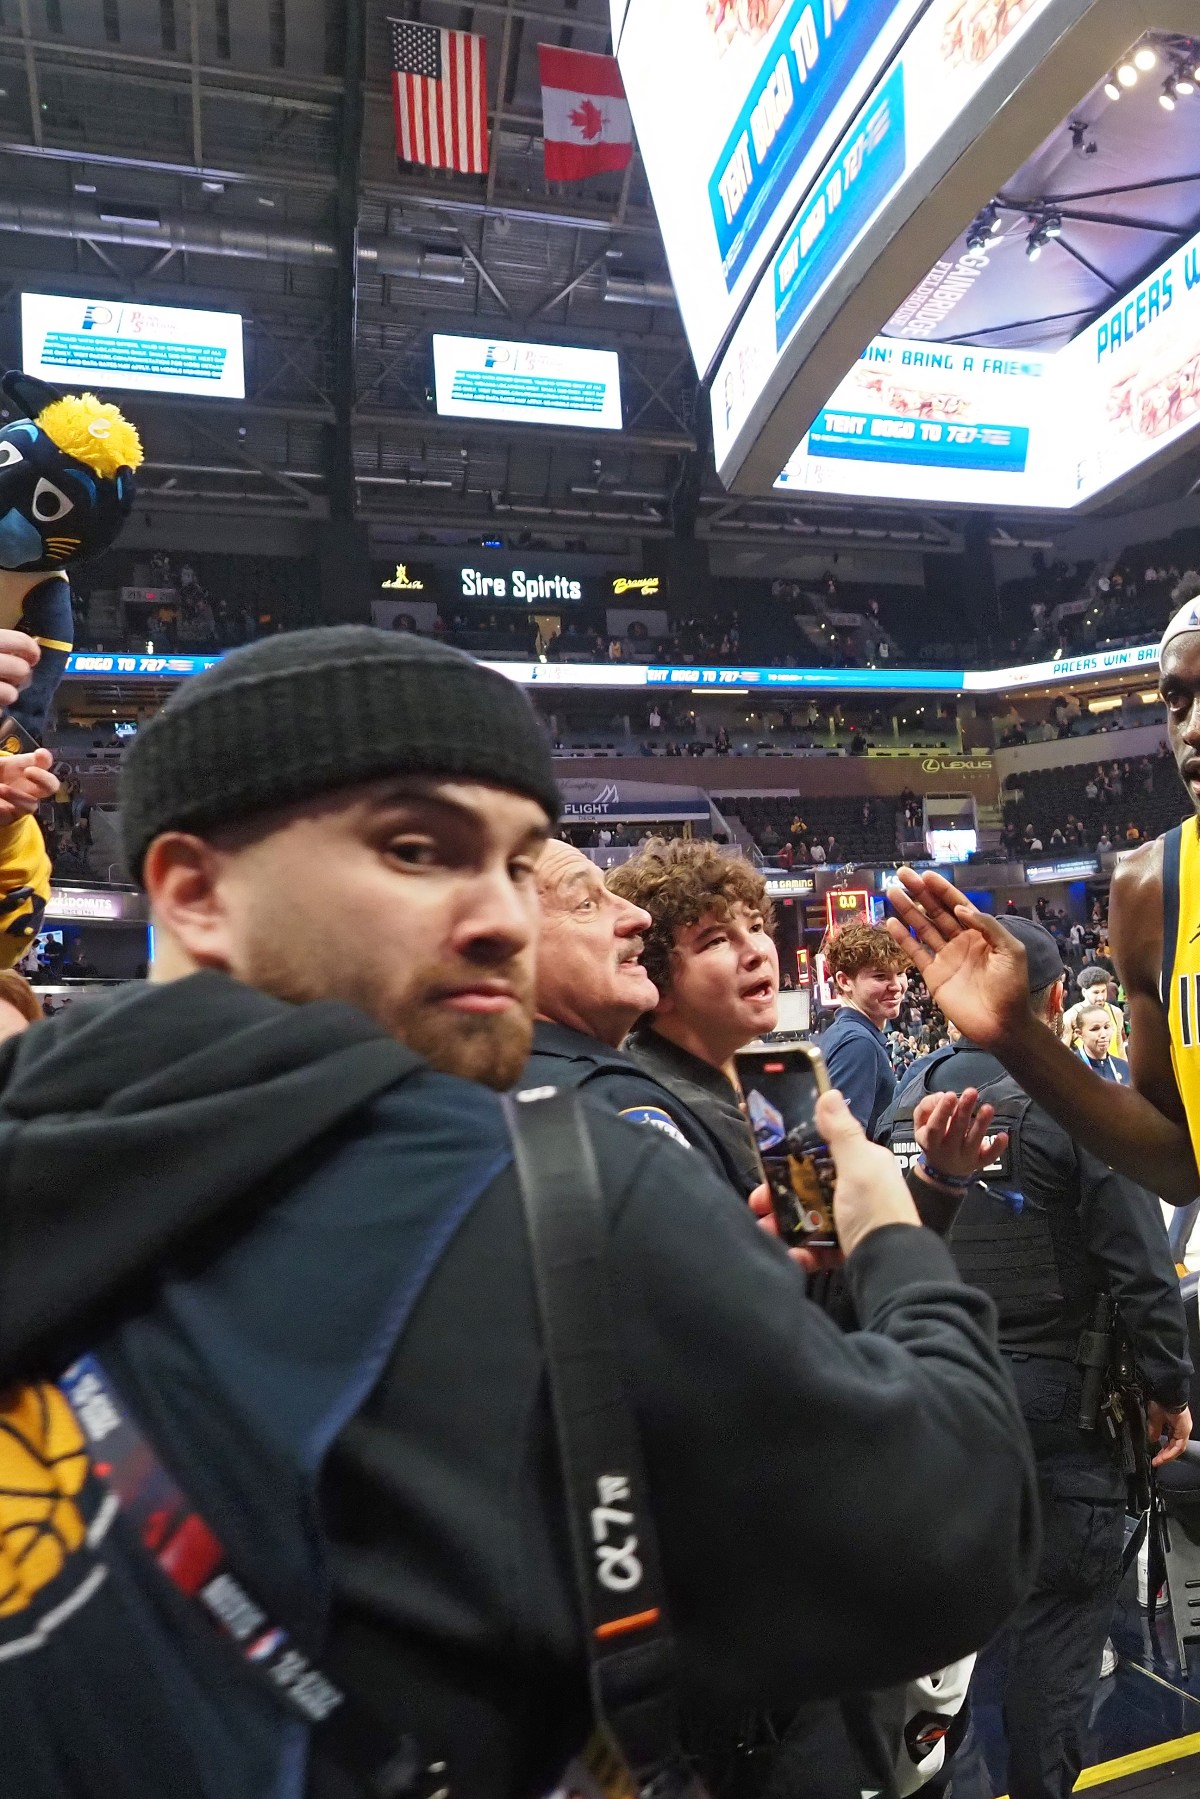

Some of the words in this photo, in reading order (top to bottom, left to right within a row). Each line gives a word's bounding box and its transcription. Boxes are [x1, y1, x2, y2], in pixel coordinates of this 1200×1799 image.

[750, 53, 794, 165] BOGO
[789, 3, 819, 84] TO
[825, 169, 841, 214] TO
[889, 260, 953, 326] FIELDHOUSE
[901, 255, 990, 336] GAINBRIDGE
[1097, 268, 1172, 363] PACERS
[902, 350, 953, 371] BRING
[963, 357, 973, 372] A
[983, 359, 1045, 377] FRIE
[870, 418, 915, 440] BOGO
[920, 424, 942, 442] TO
[461, 568, 505, 597] Sire
[511, 570, 582, 603] Spirits
[75, 656, 113, 671] BOGO
[117, 658, 136, 671] TO
[1053, 656, 1097, 675] PACERS
[1103, 652, 1132, 667] WIN!
[1137, 648, 1161, 662] BRI
[671, 670, 700, 682] BOGO
[702, 671, 716, 682] TO
[941, 759, 993, 769] LEXUS
[564, 803, 609, 814] FLIGHT
[779, 879, 814, 889] GAMING
[67, 897, 112, 909] DONUTS
[839, 895, 857, 909] 0.0
